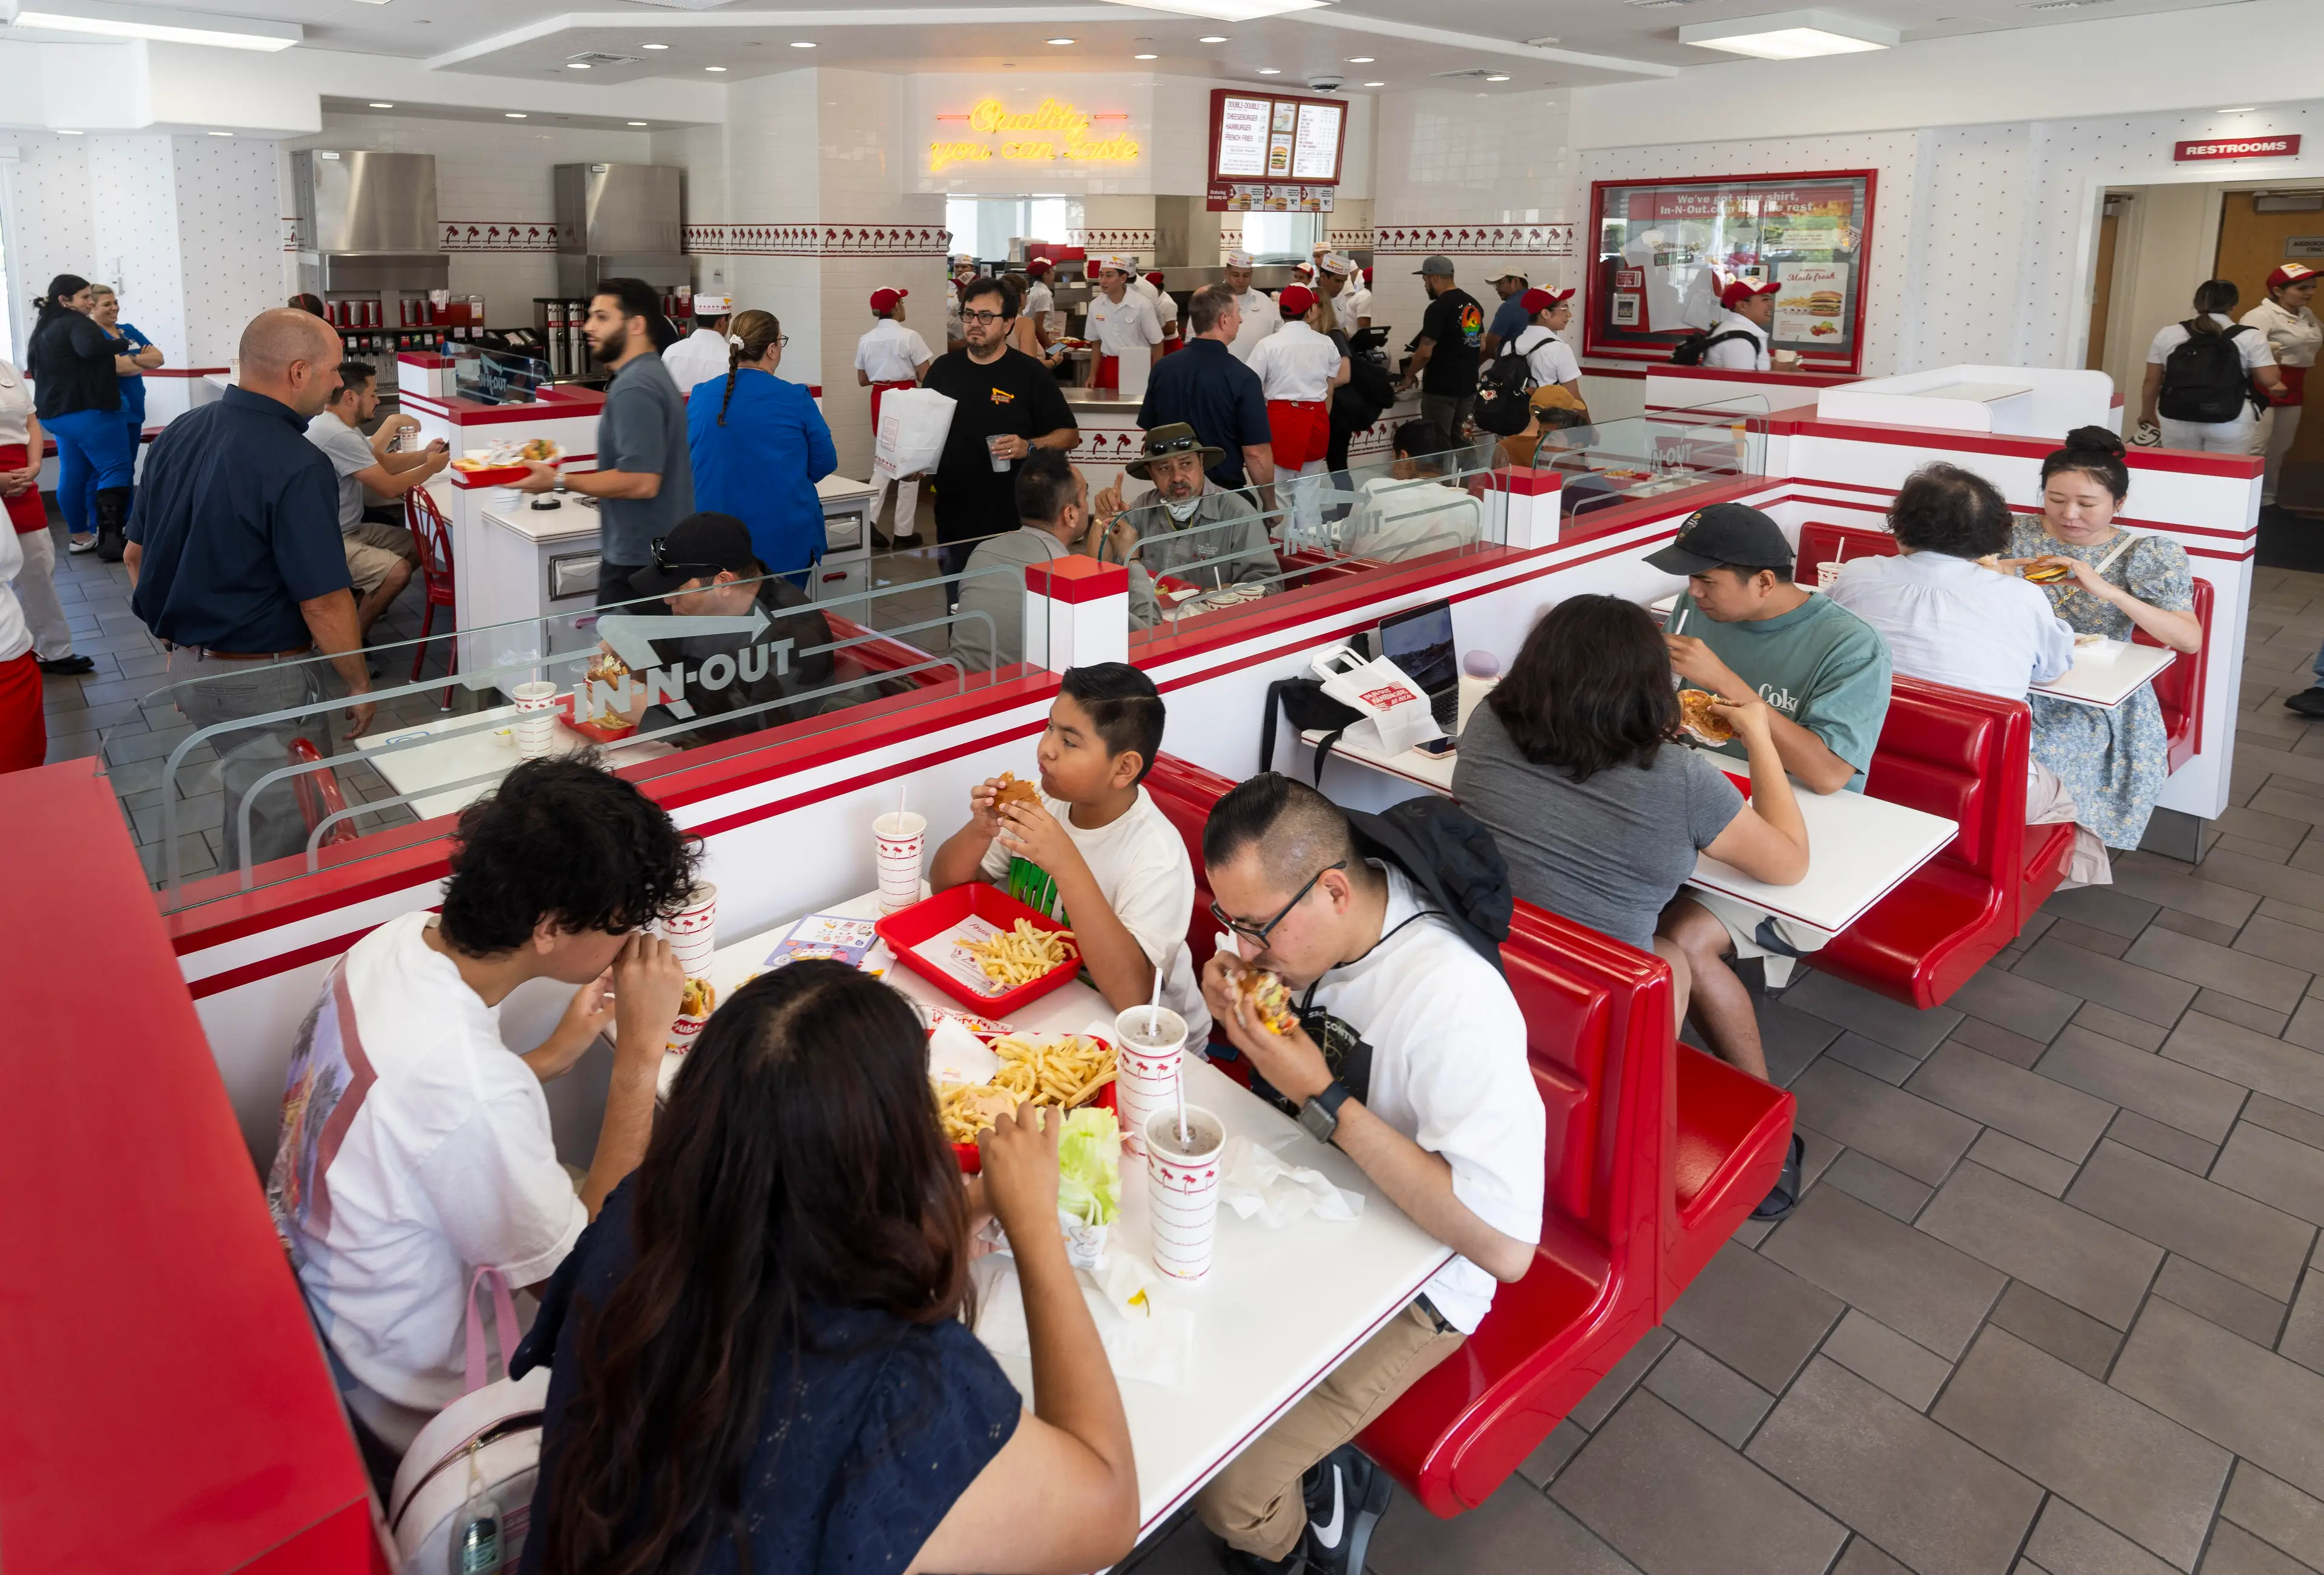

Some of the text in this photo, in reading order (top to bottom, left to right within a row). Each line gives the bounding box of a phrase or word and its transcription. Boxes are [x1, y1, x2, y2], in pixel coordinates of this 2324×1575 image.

[1227, 101, 1260, 110] DOUBLE-DOUBLE
[971, 99, 1089, 140] Quality
[931, 132, 1138, 171] you can taste
[2186, 142, 2287, 155] RESTROOMS
[1678, 192, 1799, 205] We've got your shirt,
[1787, 201, 1816, 212] rest.
[573, 638, 795, 724] IN-N-OUT
[1363, 689, 1391, 699] IN-N-OUT
